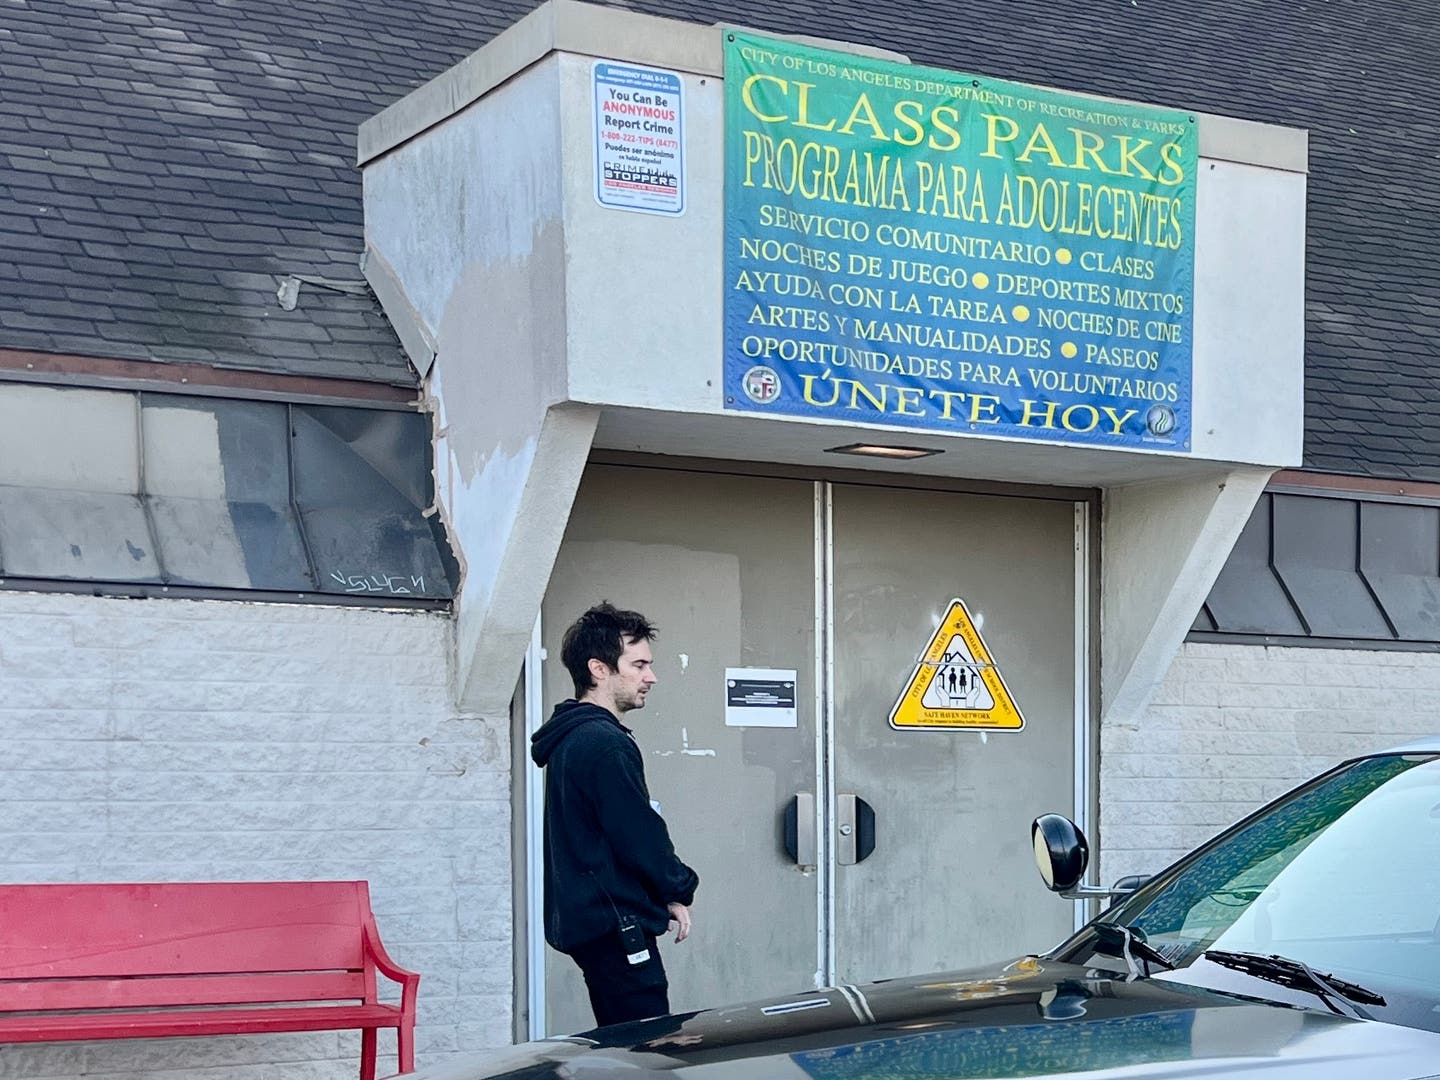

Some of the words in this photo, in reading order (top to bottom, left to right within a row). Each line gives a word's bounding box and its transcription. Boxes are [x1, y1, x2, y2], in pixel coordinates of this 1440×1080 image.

[603, 101, 676, 121] ANONYMOUS
[605, 115, 640, 130] Report
[643, 120, 674, 135] Crime
[609, 88, 630, 101] You
[632, 92, 652, 105] Can
[655, 95, 668, 107] Be
[742, 47, 780, 66] CITY
[783, 55, 803, 70] OF
[808, 61, 837, 77] LOS
[840, 68, 911, 91] ANGELES
[915, 81, 1014, 108] DEPARTMENT
[1016, 98, 1036, 113] OF
[1039, 102, 1129, 128] RECREATION
[1131, 119, 1142, 129] &
[1144, 121, 1185, 135] PARKS
[742, 73, 962, 151] CLASS
[979, 113, 1185, 186] PARKS
[604, 161, 648, 174] CRIME
[605, 170, 677, 186] STOPPERS
[742, 131, 911, 211] PROGRAMA
[916, 161, 989, 223] PARA
[995, 173, 1183, 249] ADOLECENTES
[739, 238, 841, 273] NOCHES
[848, 254, 882, 278] DE
[889, 259, 968, 289] JUEGO
[996, 273, 1111, 305] DEPORTES
[1114, 287, 1183, 315] MIXTOS
[759, 205, 870, 242] SERVICIO
[876, 224, 1051, 266] COMUNITARIO
[1080, 251, 1154, 280] CLASES
[734, 270, 825, 300] AYUDA
[828, 284, 883, 309] CON
[889, 291, 922, 315] LA
[928, 295, 1008, 324] TAREA
[1037, 308, 1113, 336] NOCHES
[1116, 319, 1140, 339] DE
[1145, 321, 1183, 344] CINE
[747, 304, 830, 332] ARTES
[834, 315, 848, 336] Y
[854, 319, 1051, 359] MANUALIDADES
[1085, 343, 1159, 371] PASEOS
[742, 335, 953, 380] OPORTUNIDADES
[957, 362, 1022, 387] PARA
[1027, 368, 1178, 401] VOLUNTARIOS
[798, 367, 1000, 424] ÚNETE
[1016, 398, 1139, 436] HOY
